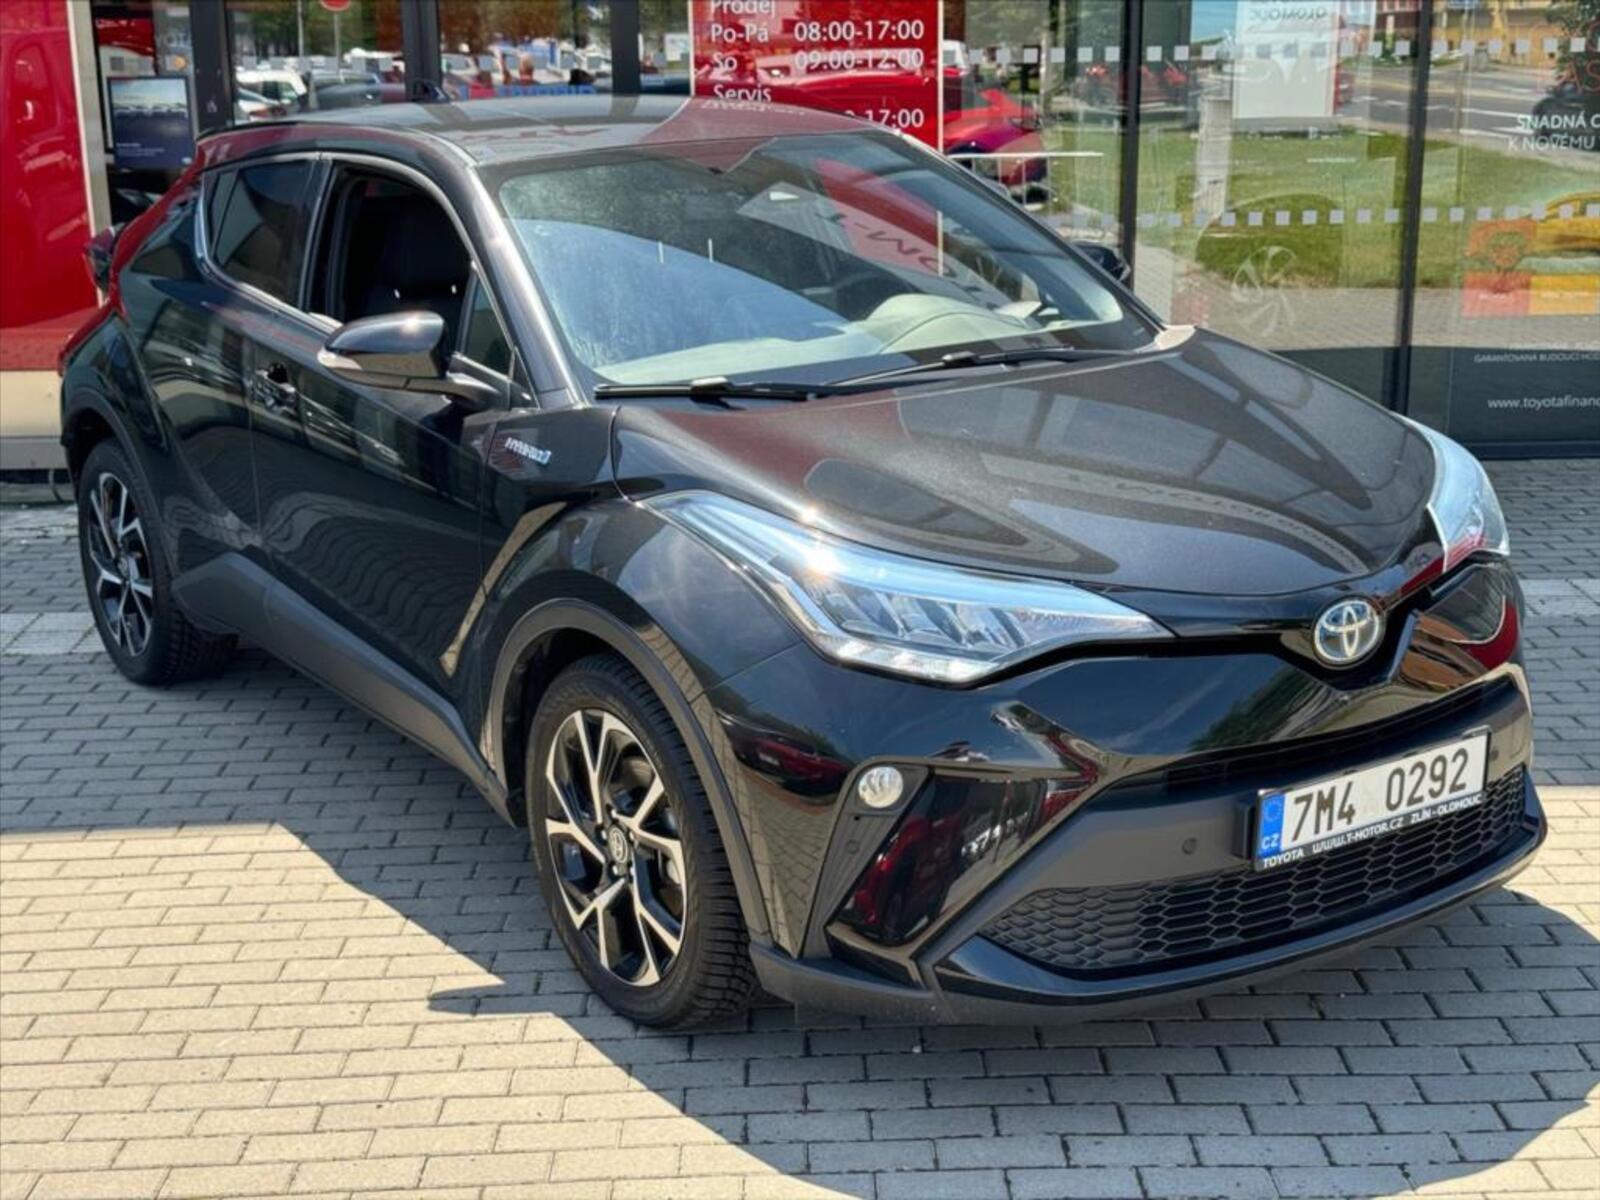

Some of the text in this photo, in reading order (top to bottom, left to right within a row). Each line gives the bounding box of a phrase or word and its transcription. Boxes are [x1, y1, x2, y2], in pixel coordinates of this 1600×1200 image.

[710, 0, 775, 18] Prodej
[710, 20, 925, 43] Po-Pá 08:00-17:00
[713, 49, 925, 72] So 09:00-12:00
[713, 84, 772, 102] Servis
[1517, 110, 1587, 130] SNADNÁ
[1291, 747, 1469, 842] 7M4 0292
[1261, 833, 1280, 850] CZ
[1263, 848, 1305, 869] TOYOTA
